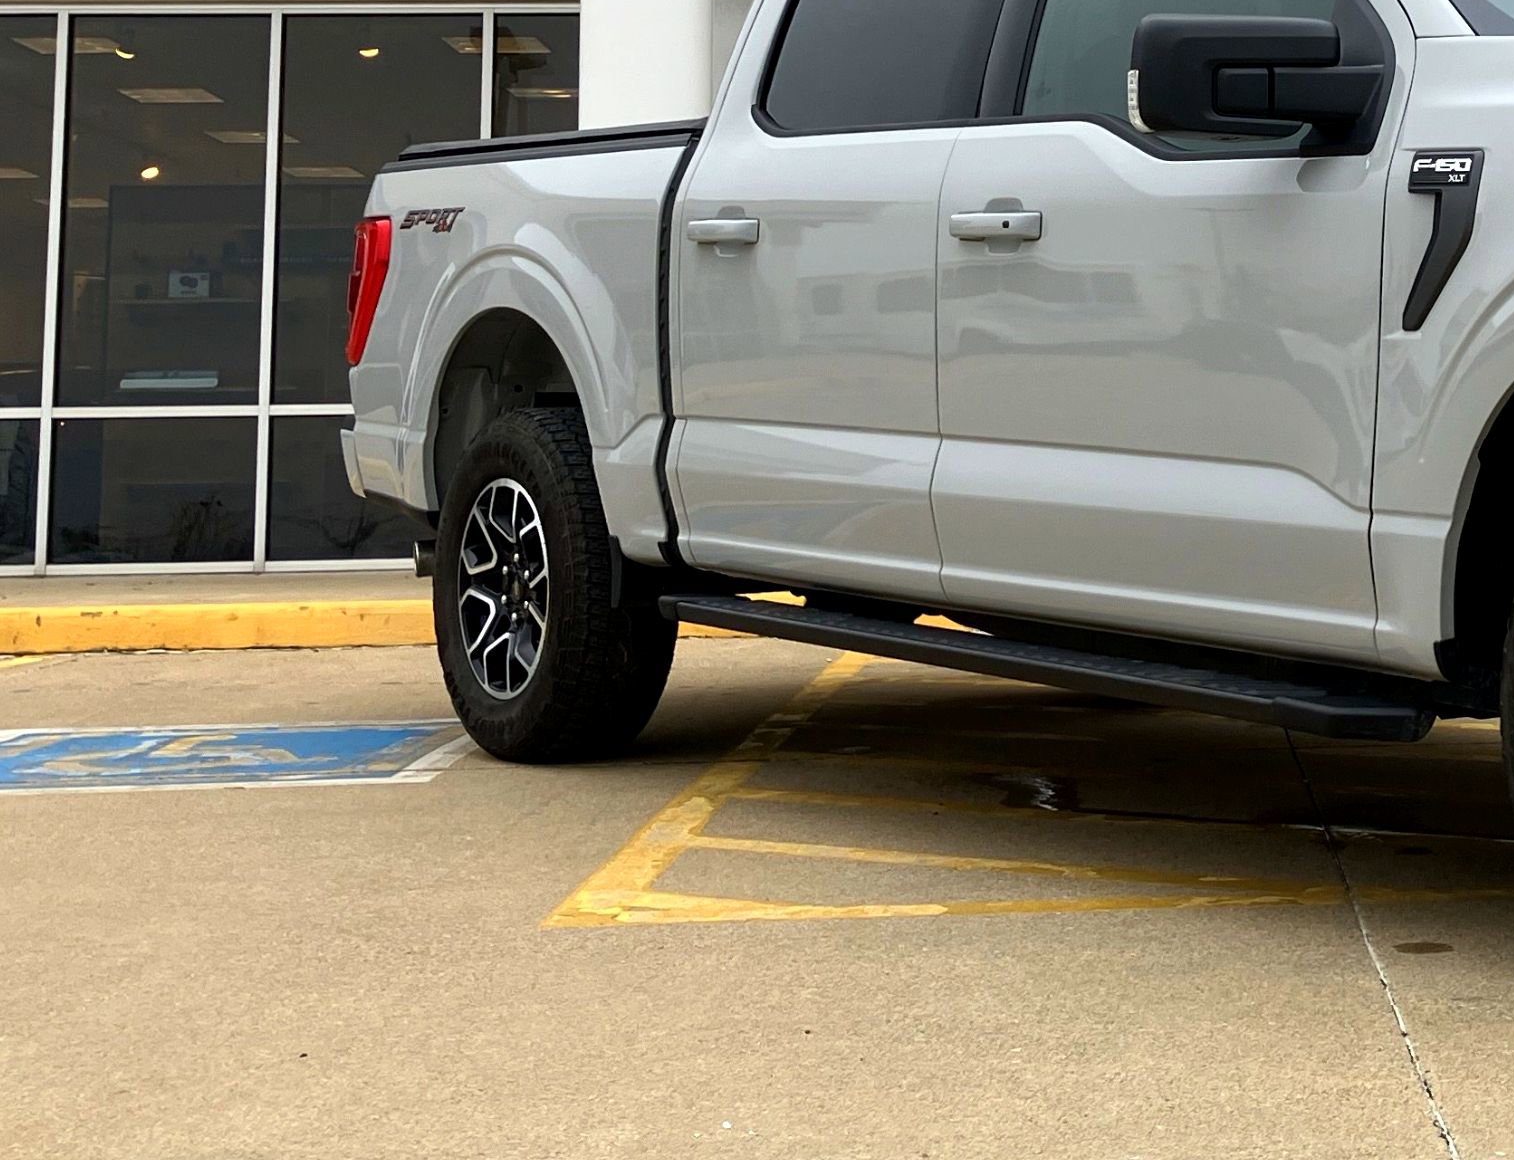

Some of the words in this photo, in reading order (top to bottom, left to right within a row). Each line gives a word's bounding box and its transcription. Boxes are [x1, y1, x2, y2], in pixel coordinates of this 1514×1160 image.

[1413, 158, 1473, 172] F-150
[1448, 174, 1466, 183] XLT
[399, 206, 466, 230] SPORT
